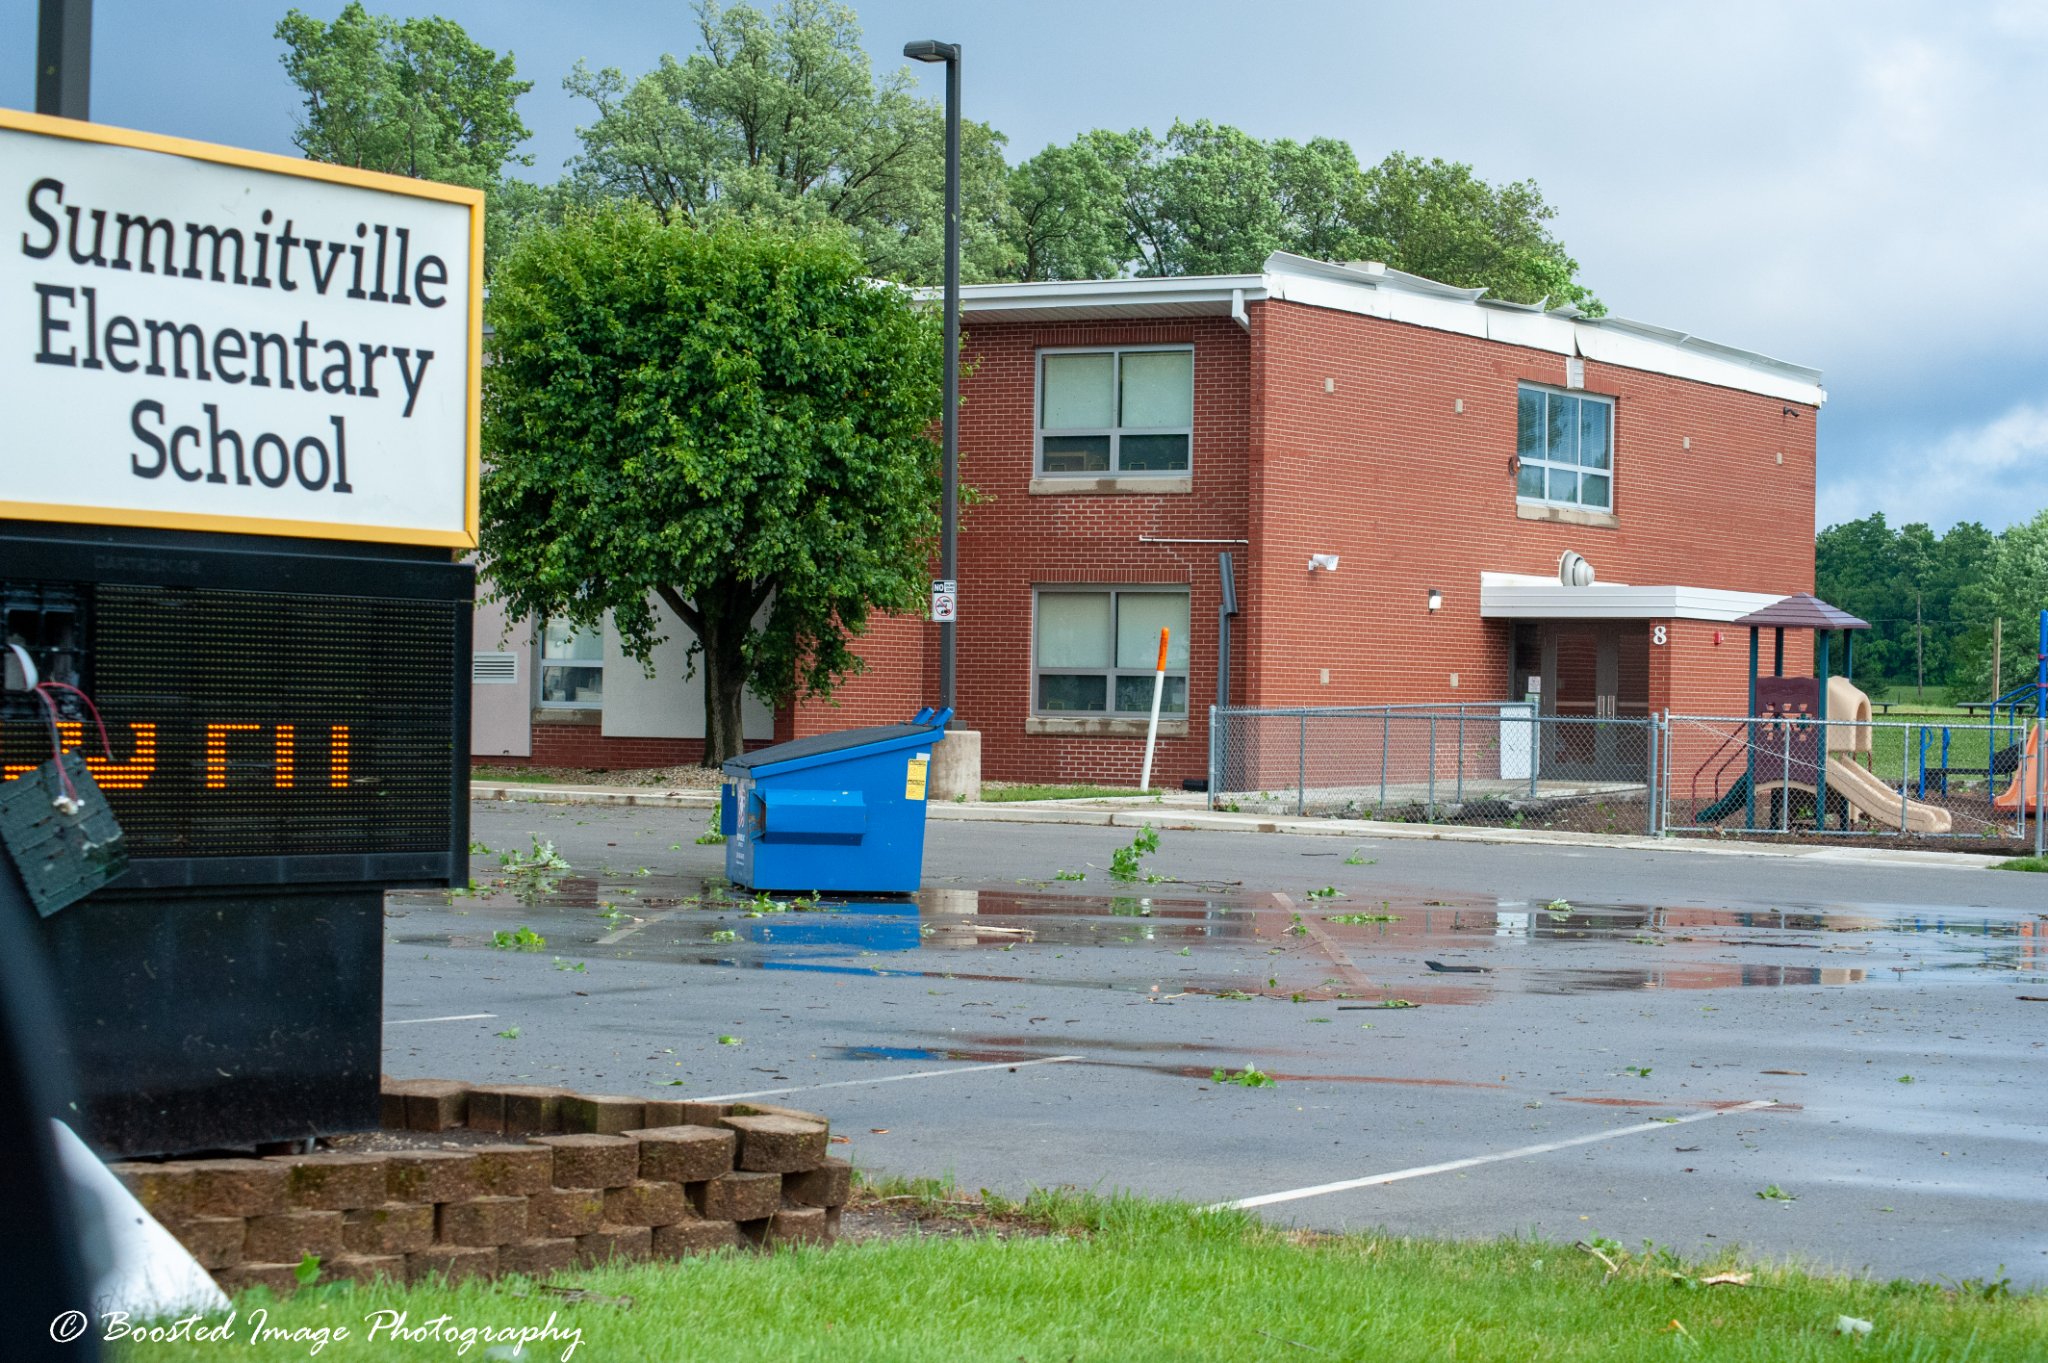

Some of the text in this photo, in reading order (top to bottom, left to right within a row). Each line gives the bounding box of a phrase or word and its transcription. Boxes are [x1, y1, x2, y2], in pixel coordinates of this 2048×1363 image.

[21, 177, 449, 309] Summitville
[33, 281, 435, 418] Elementary
[129, 398, 354, 494] School
[934, 583, 944, 592] NO
[1653, 625, 1667, 645] 8
